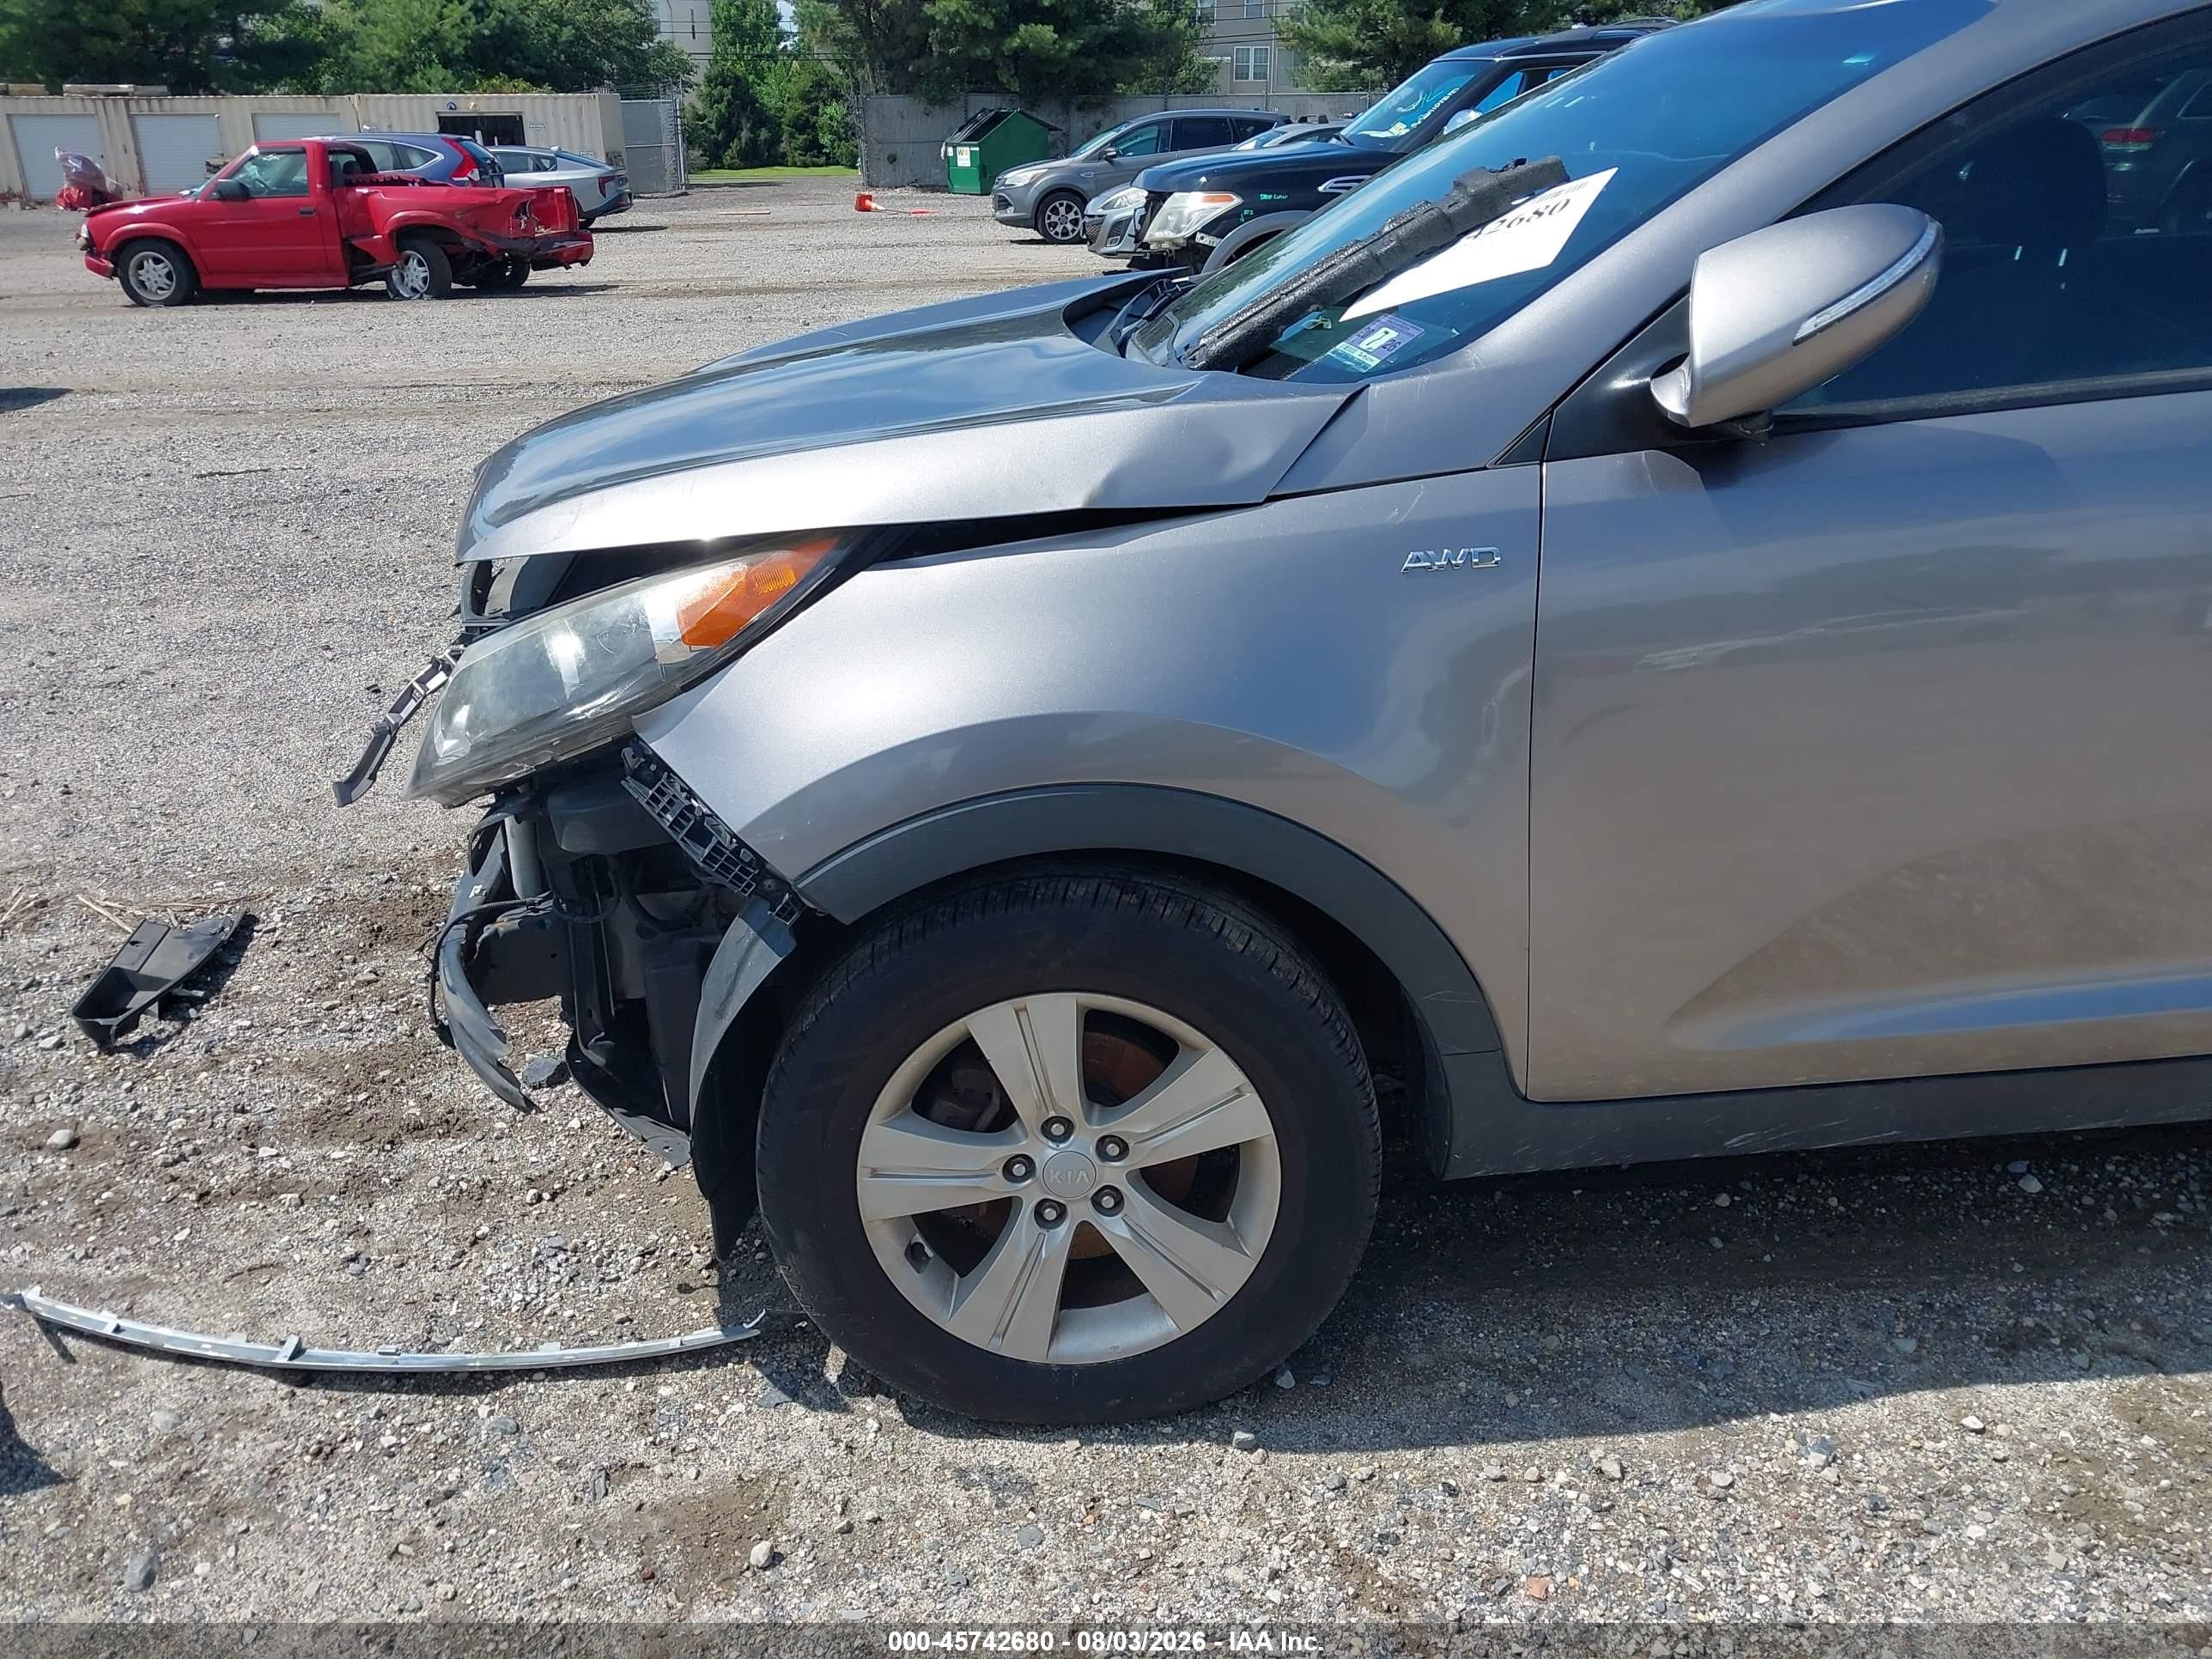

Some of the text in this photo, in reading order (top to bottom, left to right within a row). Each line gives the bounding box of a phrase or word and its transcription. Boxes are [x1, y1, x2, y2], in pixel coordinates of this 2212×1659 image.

[1382, 339, 1402, 352] 26
[1401, 546, 1503, 574] AWD
[1048, 1169, 1091, 1184] KIA
